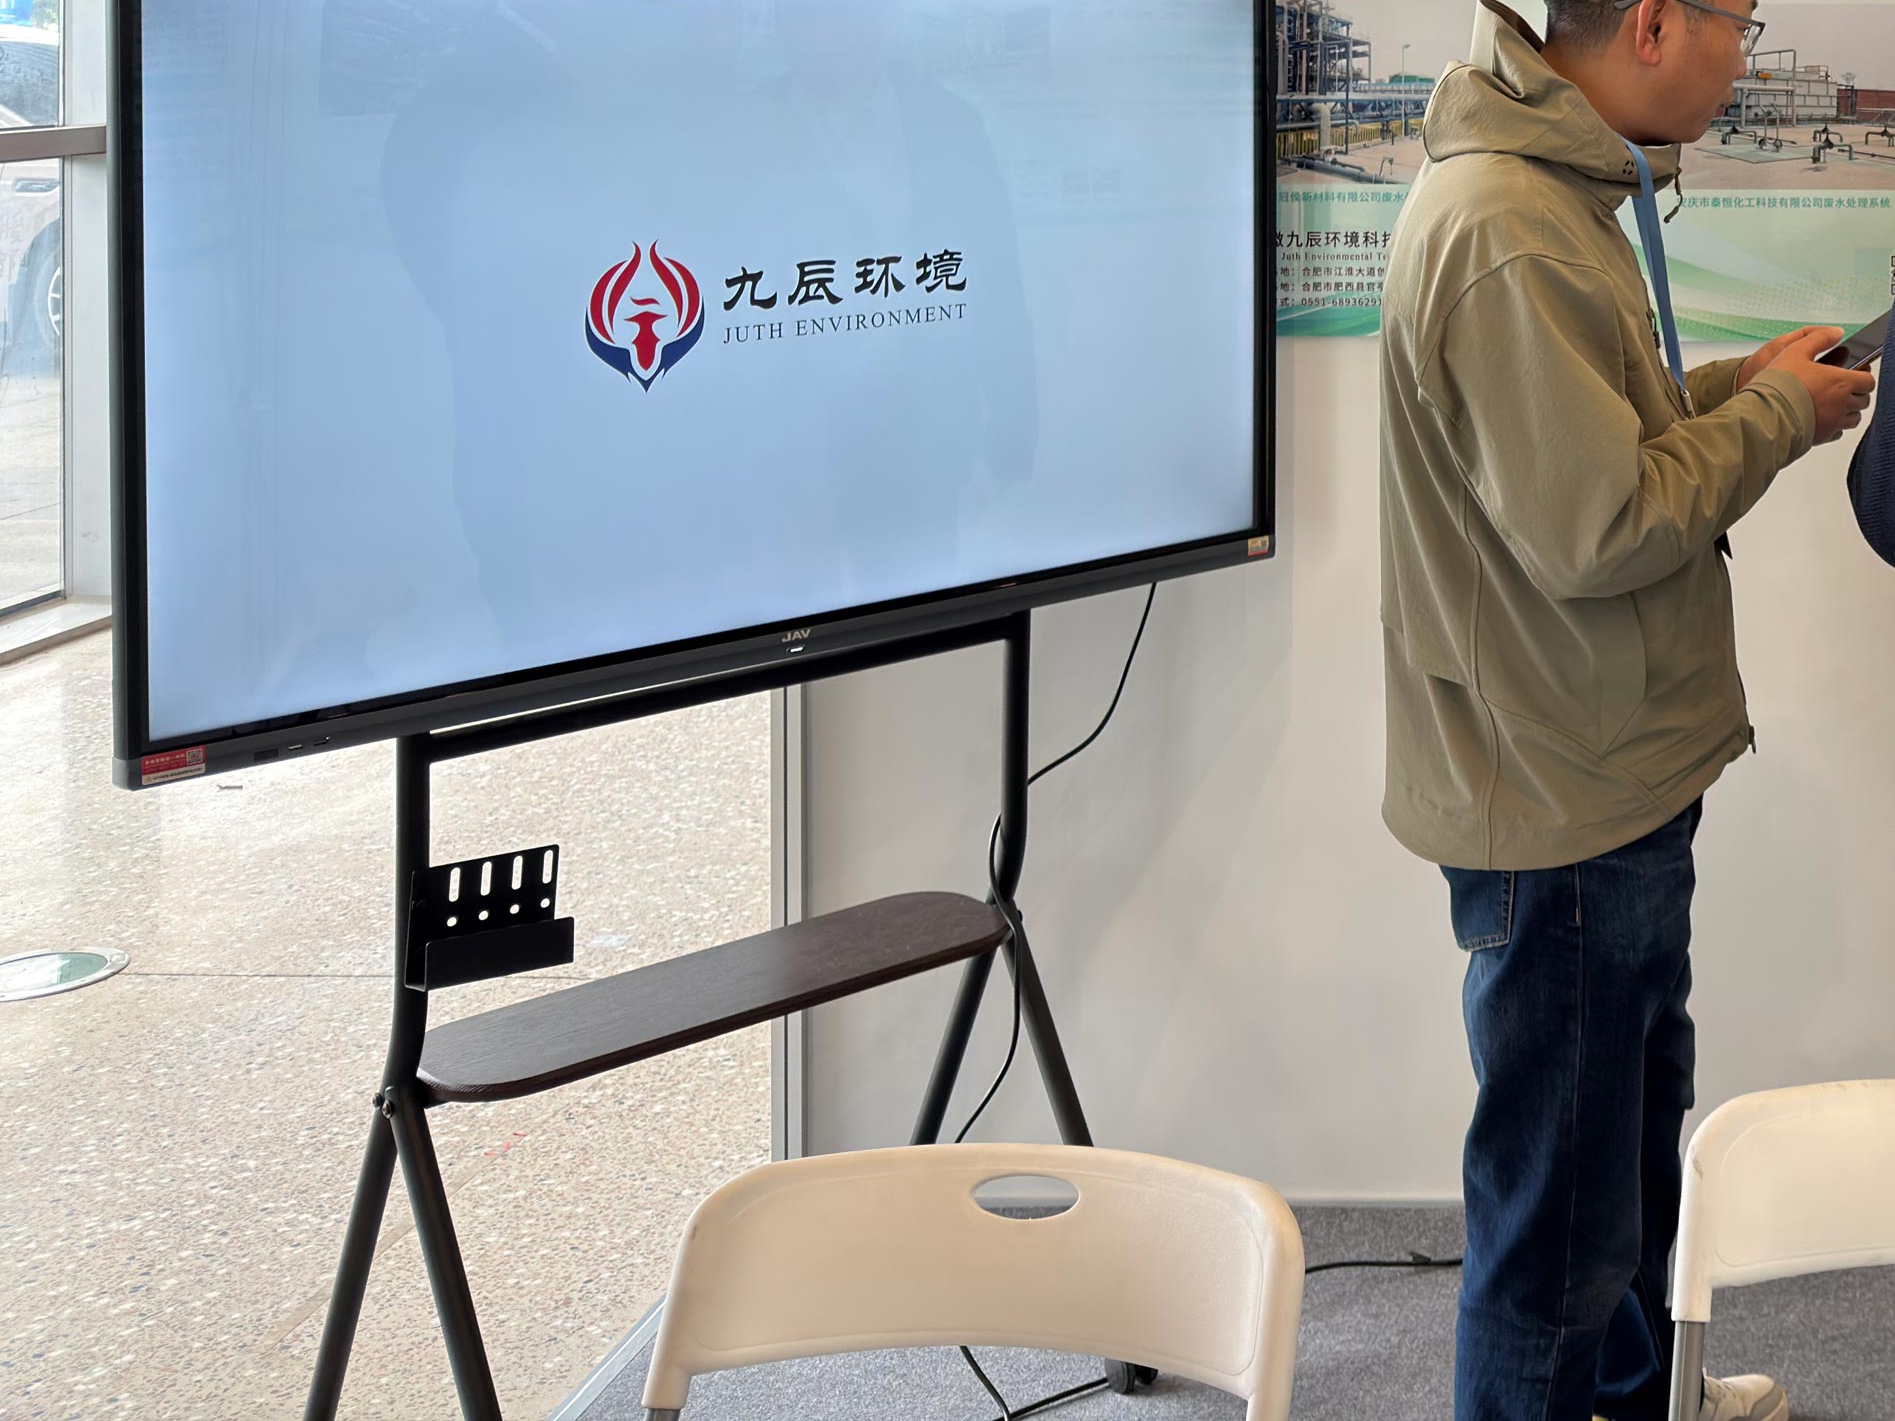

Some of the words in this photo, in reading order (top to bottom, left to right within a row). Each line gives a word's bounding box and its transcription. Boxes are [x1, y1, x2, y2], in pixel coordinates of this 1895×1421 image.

[1304, 252, 1373, 261] Environmental
[1276, 266, 1385, 277] 地：合肥市江淮大道创
[722, 249, 968, 312] 九辰环境
[1276, 281, 1384, 292] 地：合肥市肥西县官
[722, 322, 784, 345] JUTH
[795, 303, 968, 338] ENVIRONMENT
